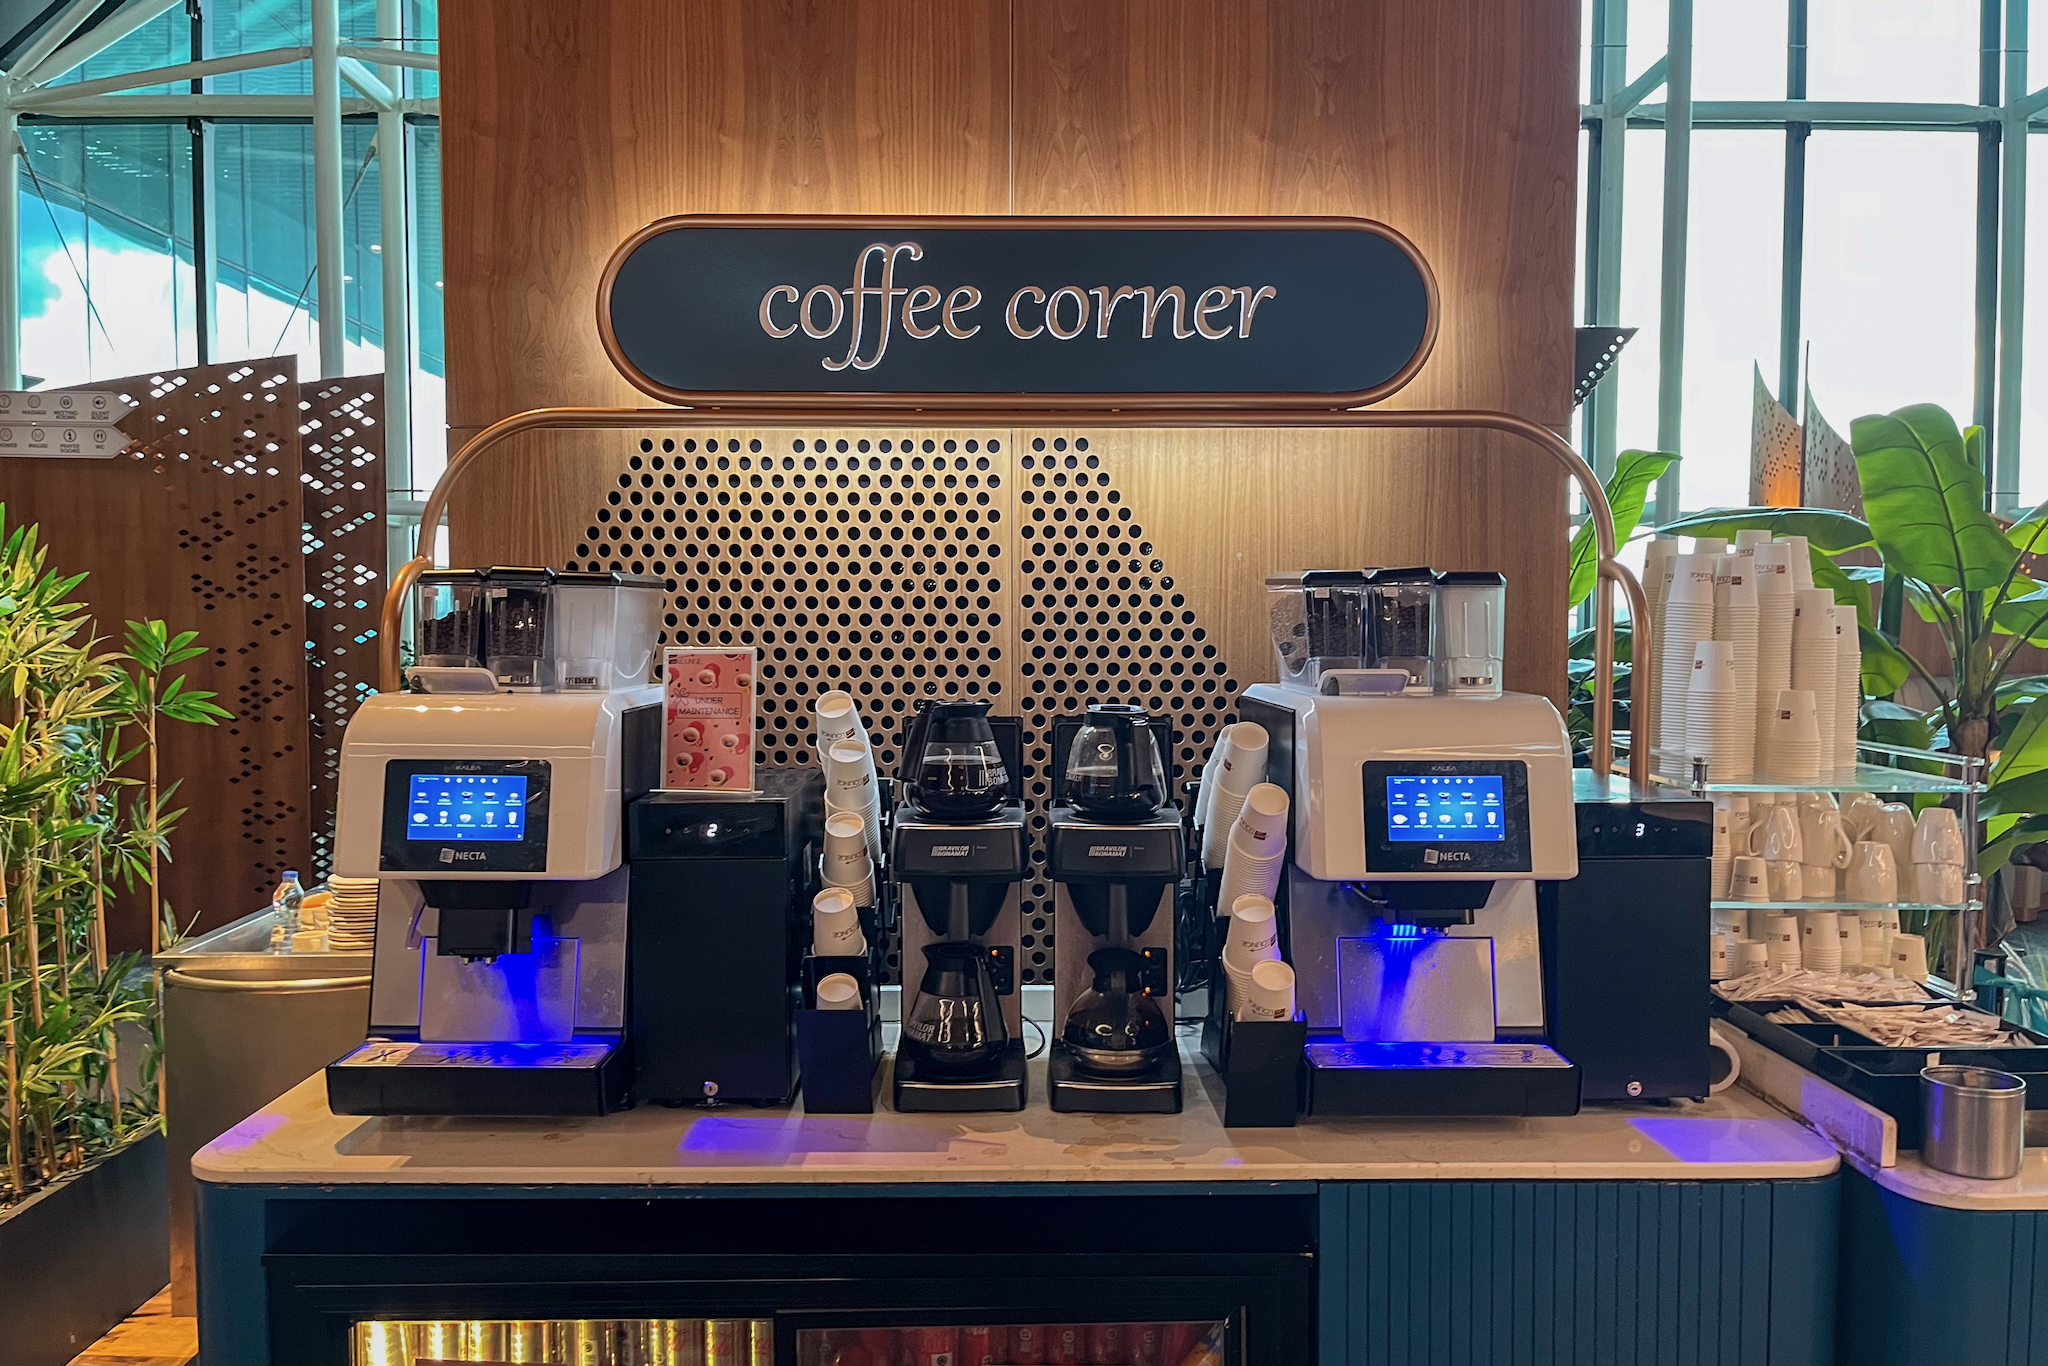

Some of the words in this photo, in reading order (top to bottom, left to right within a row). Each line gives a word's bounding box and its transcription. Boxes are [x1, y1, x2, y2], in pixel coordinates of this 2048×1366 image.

[759, 242, 982, 372] coffee
[1005, 285, 1277, 340] corner
[695, 697, 723, 705] UNDER
[706, 823, 718, 837] 2
[1635, 823, 1646, 837] 3
[455, 851, 486, 861] NECTA
[1440, 852, 1471, 861] NECTA
